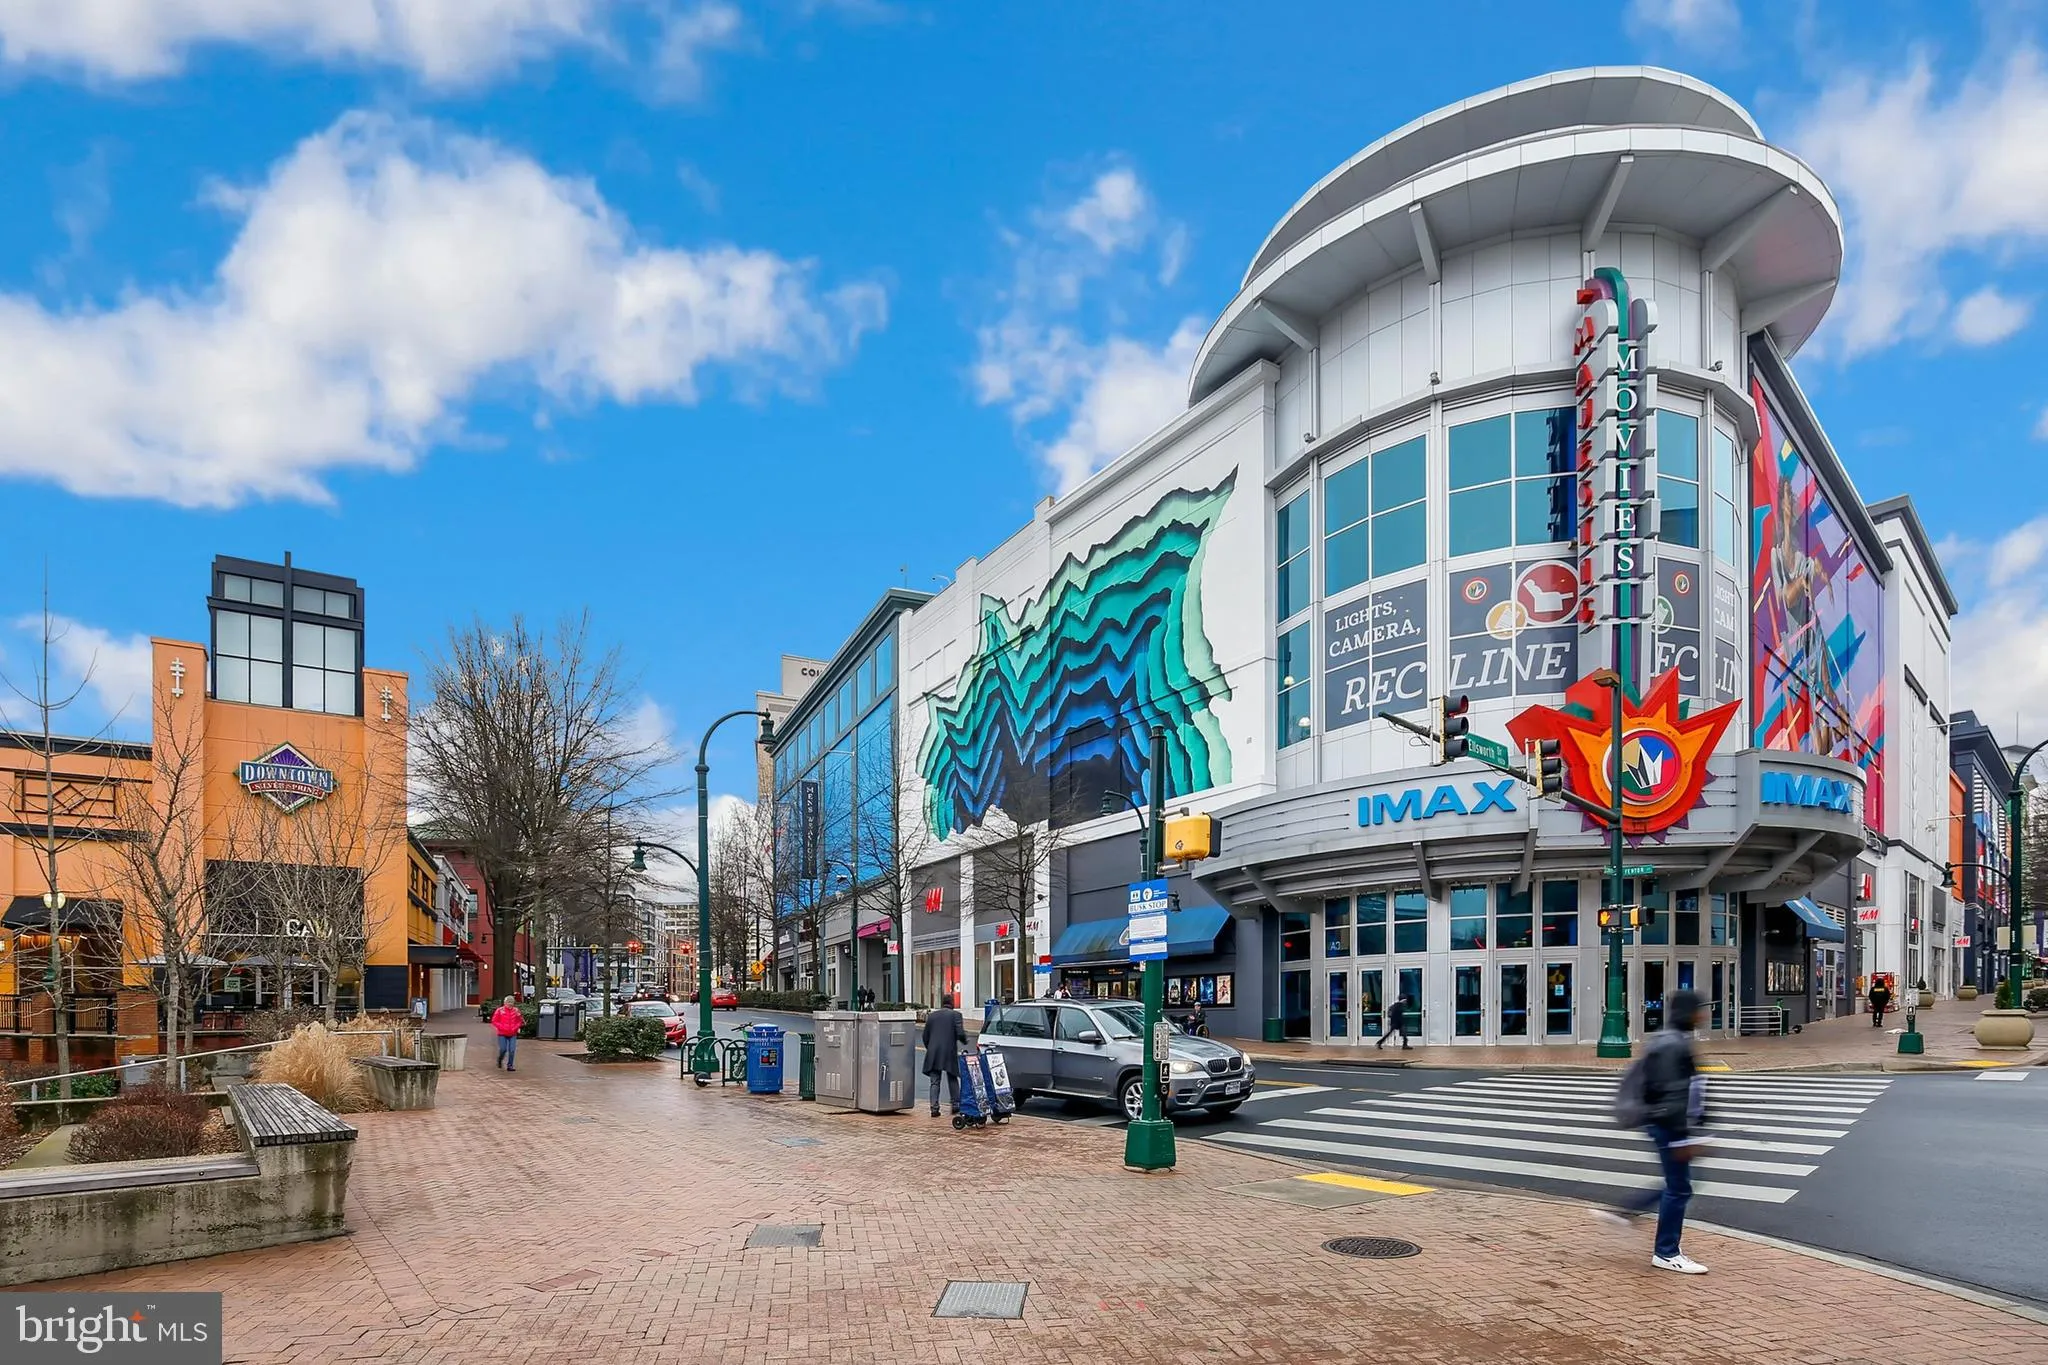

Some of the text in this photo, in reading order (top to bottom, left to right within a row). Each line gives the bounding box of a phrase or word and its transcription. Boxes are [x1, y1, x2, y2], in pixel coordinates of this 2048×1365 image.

[1615, 348, 1638, 572] MOVIES
[1335, 601, 1398, 632] LIGHTS,
[1329, 618, 1421, 658] CAMERA,
[1650, 641, 1699, 682] EC
[1340, 660, 1427, 715] REC
[1468, 738, 1495, 759] Ellsworth
[244, 765, 328, 788] DOWNTOWN
[1761, 772, 1853, 812] IMAX
[1358, 779, 1517, 828] IMAX
[1624, 867, 1644, 875] FENTON
[1129, 900, 1166, 913] BUSK STOP
